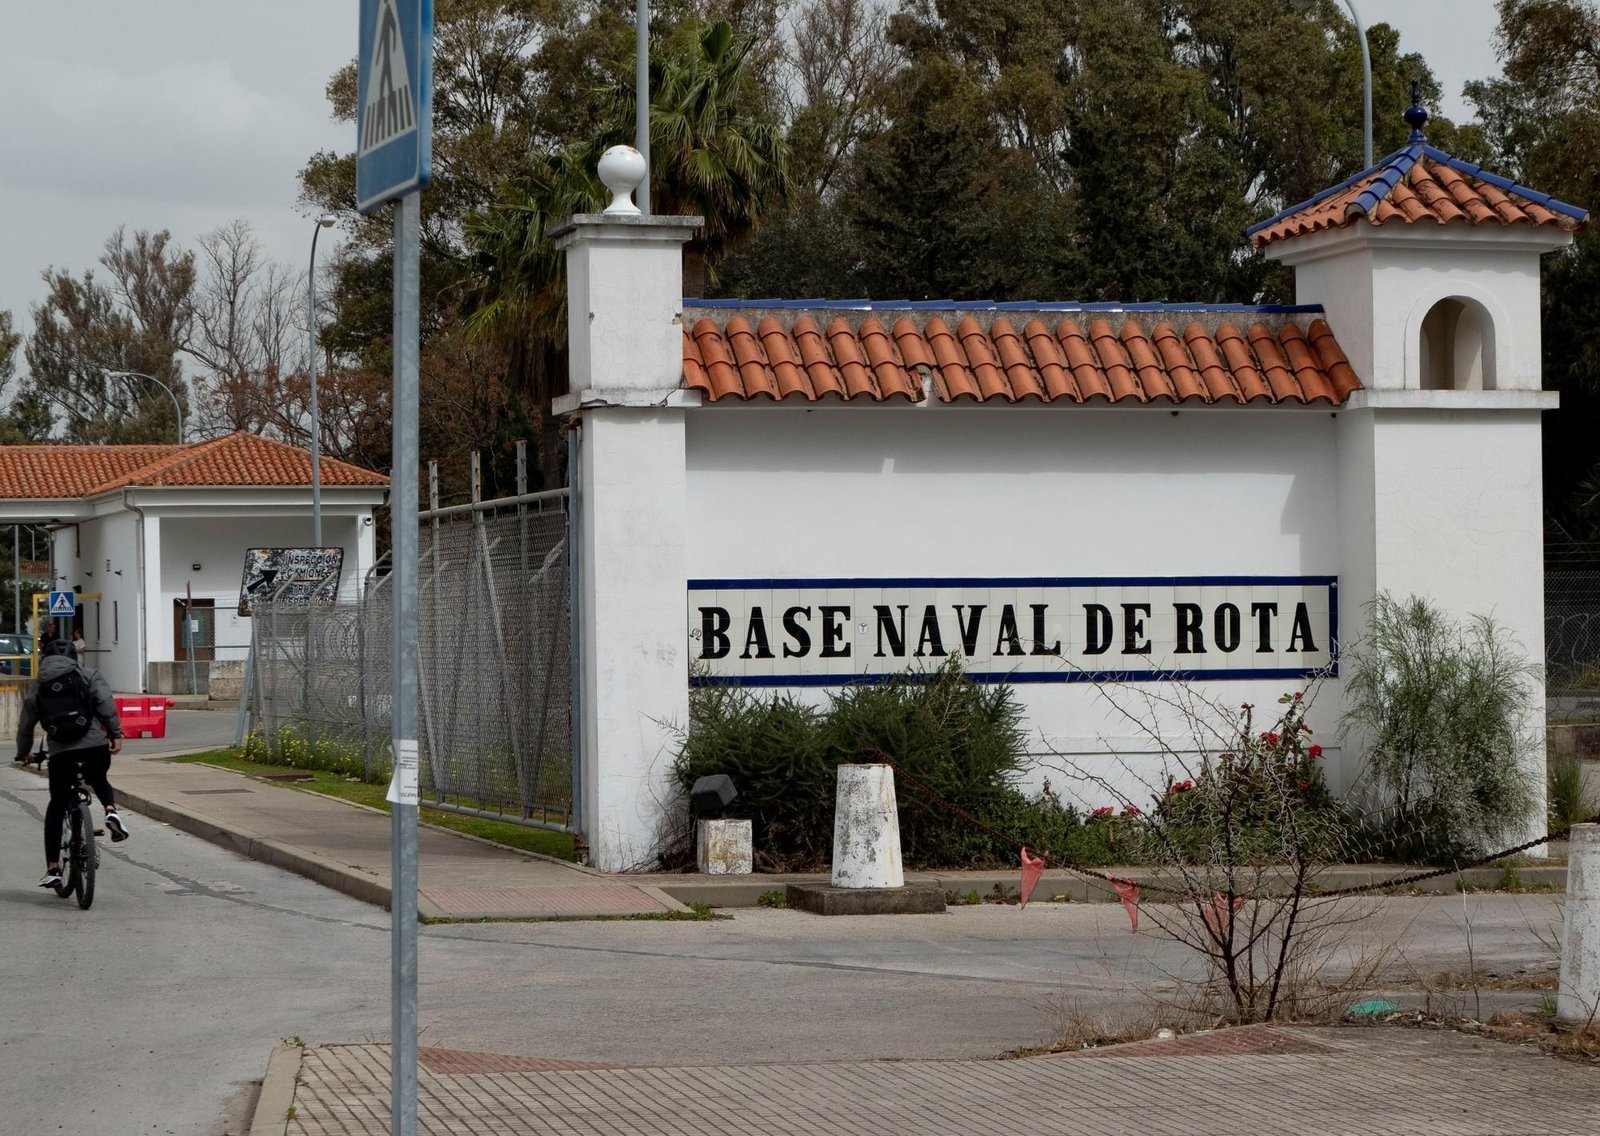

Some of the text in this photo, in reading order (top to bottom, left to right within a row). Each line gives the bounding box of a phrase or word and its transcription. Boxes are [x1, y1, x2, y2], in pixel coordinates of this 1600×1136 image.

[278, 596, 330, 607] INSPECION
[698, 602, 1320, 659] BASE NAVAL DE ROTA
